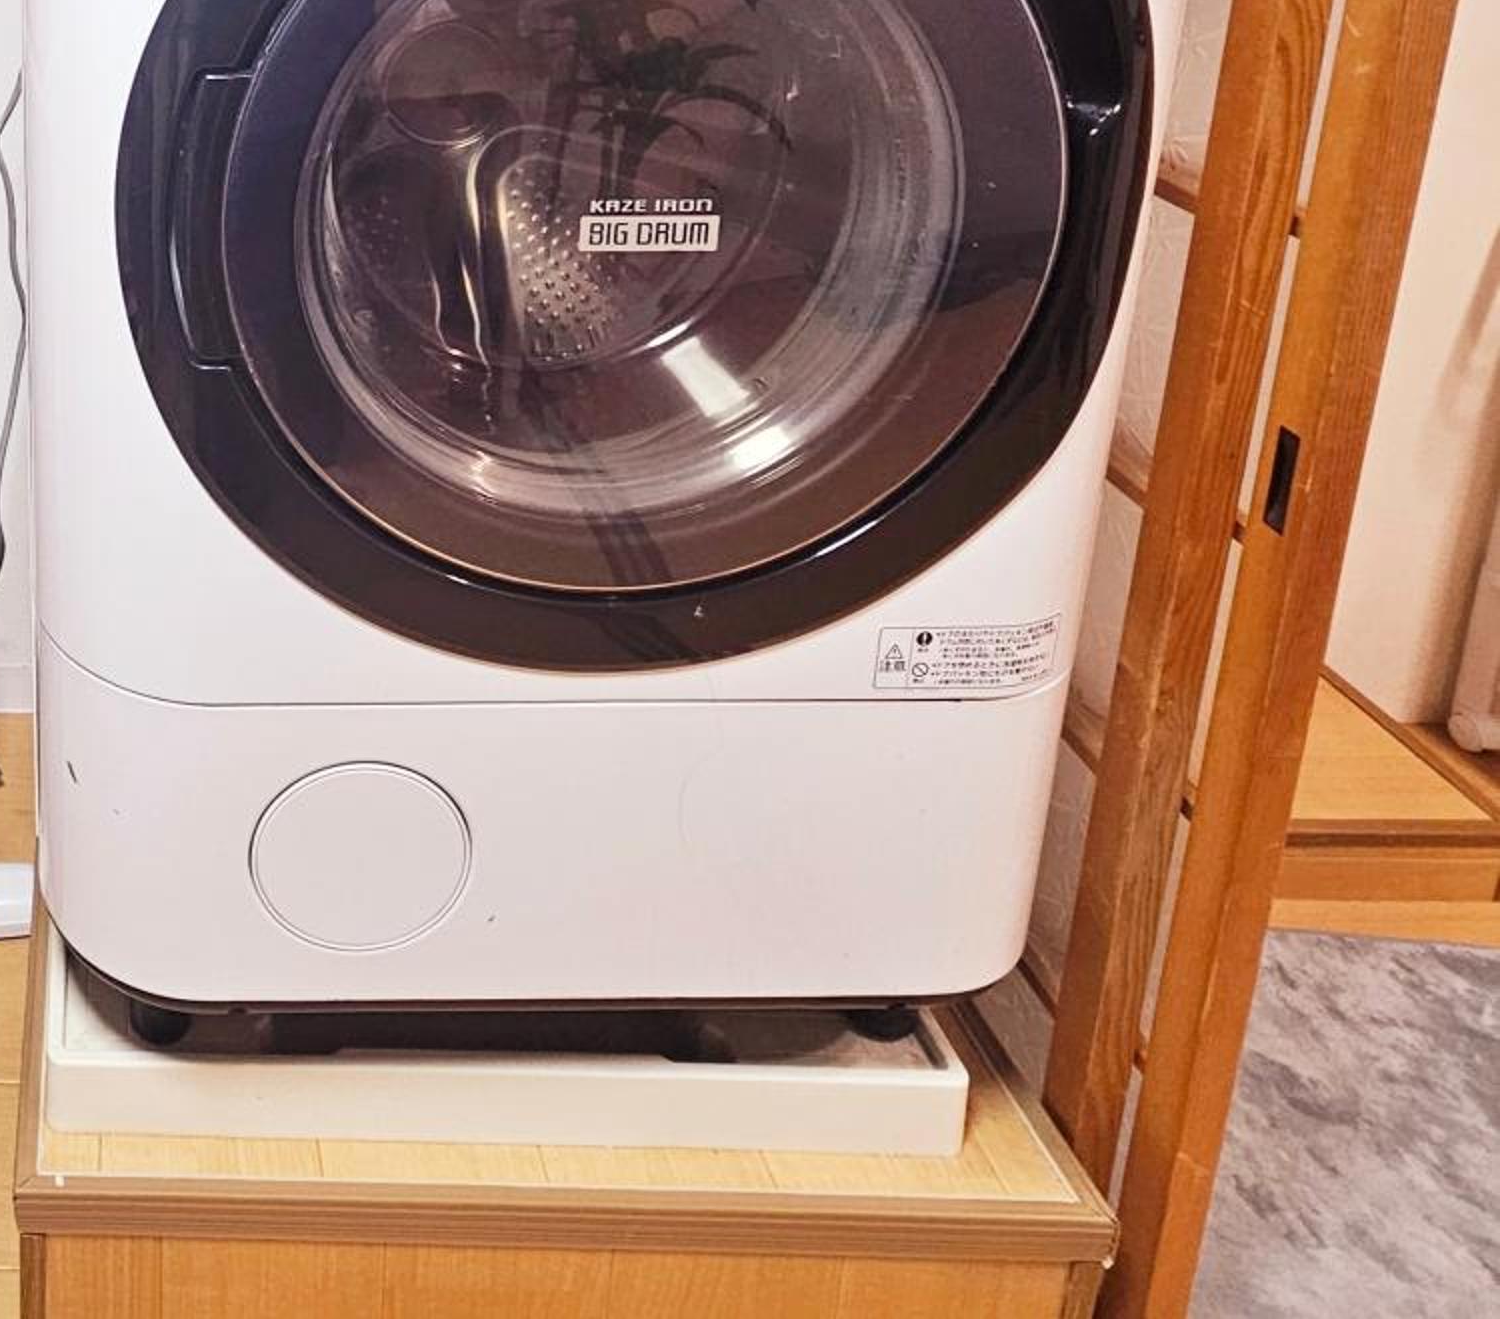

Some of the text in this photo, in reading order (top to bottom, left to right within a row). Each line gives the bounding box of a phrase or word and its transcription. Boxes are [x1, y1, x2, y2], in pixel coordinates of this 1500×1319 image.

[589, 198, 714, 213] KAZE IRON
[588, 222, 710, 246] BIG DRUM
